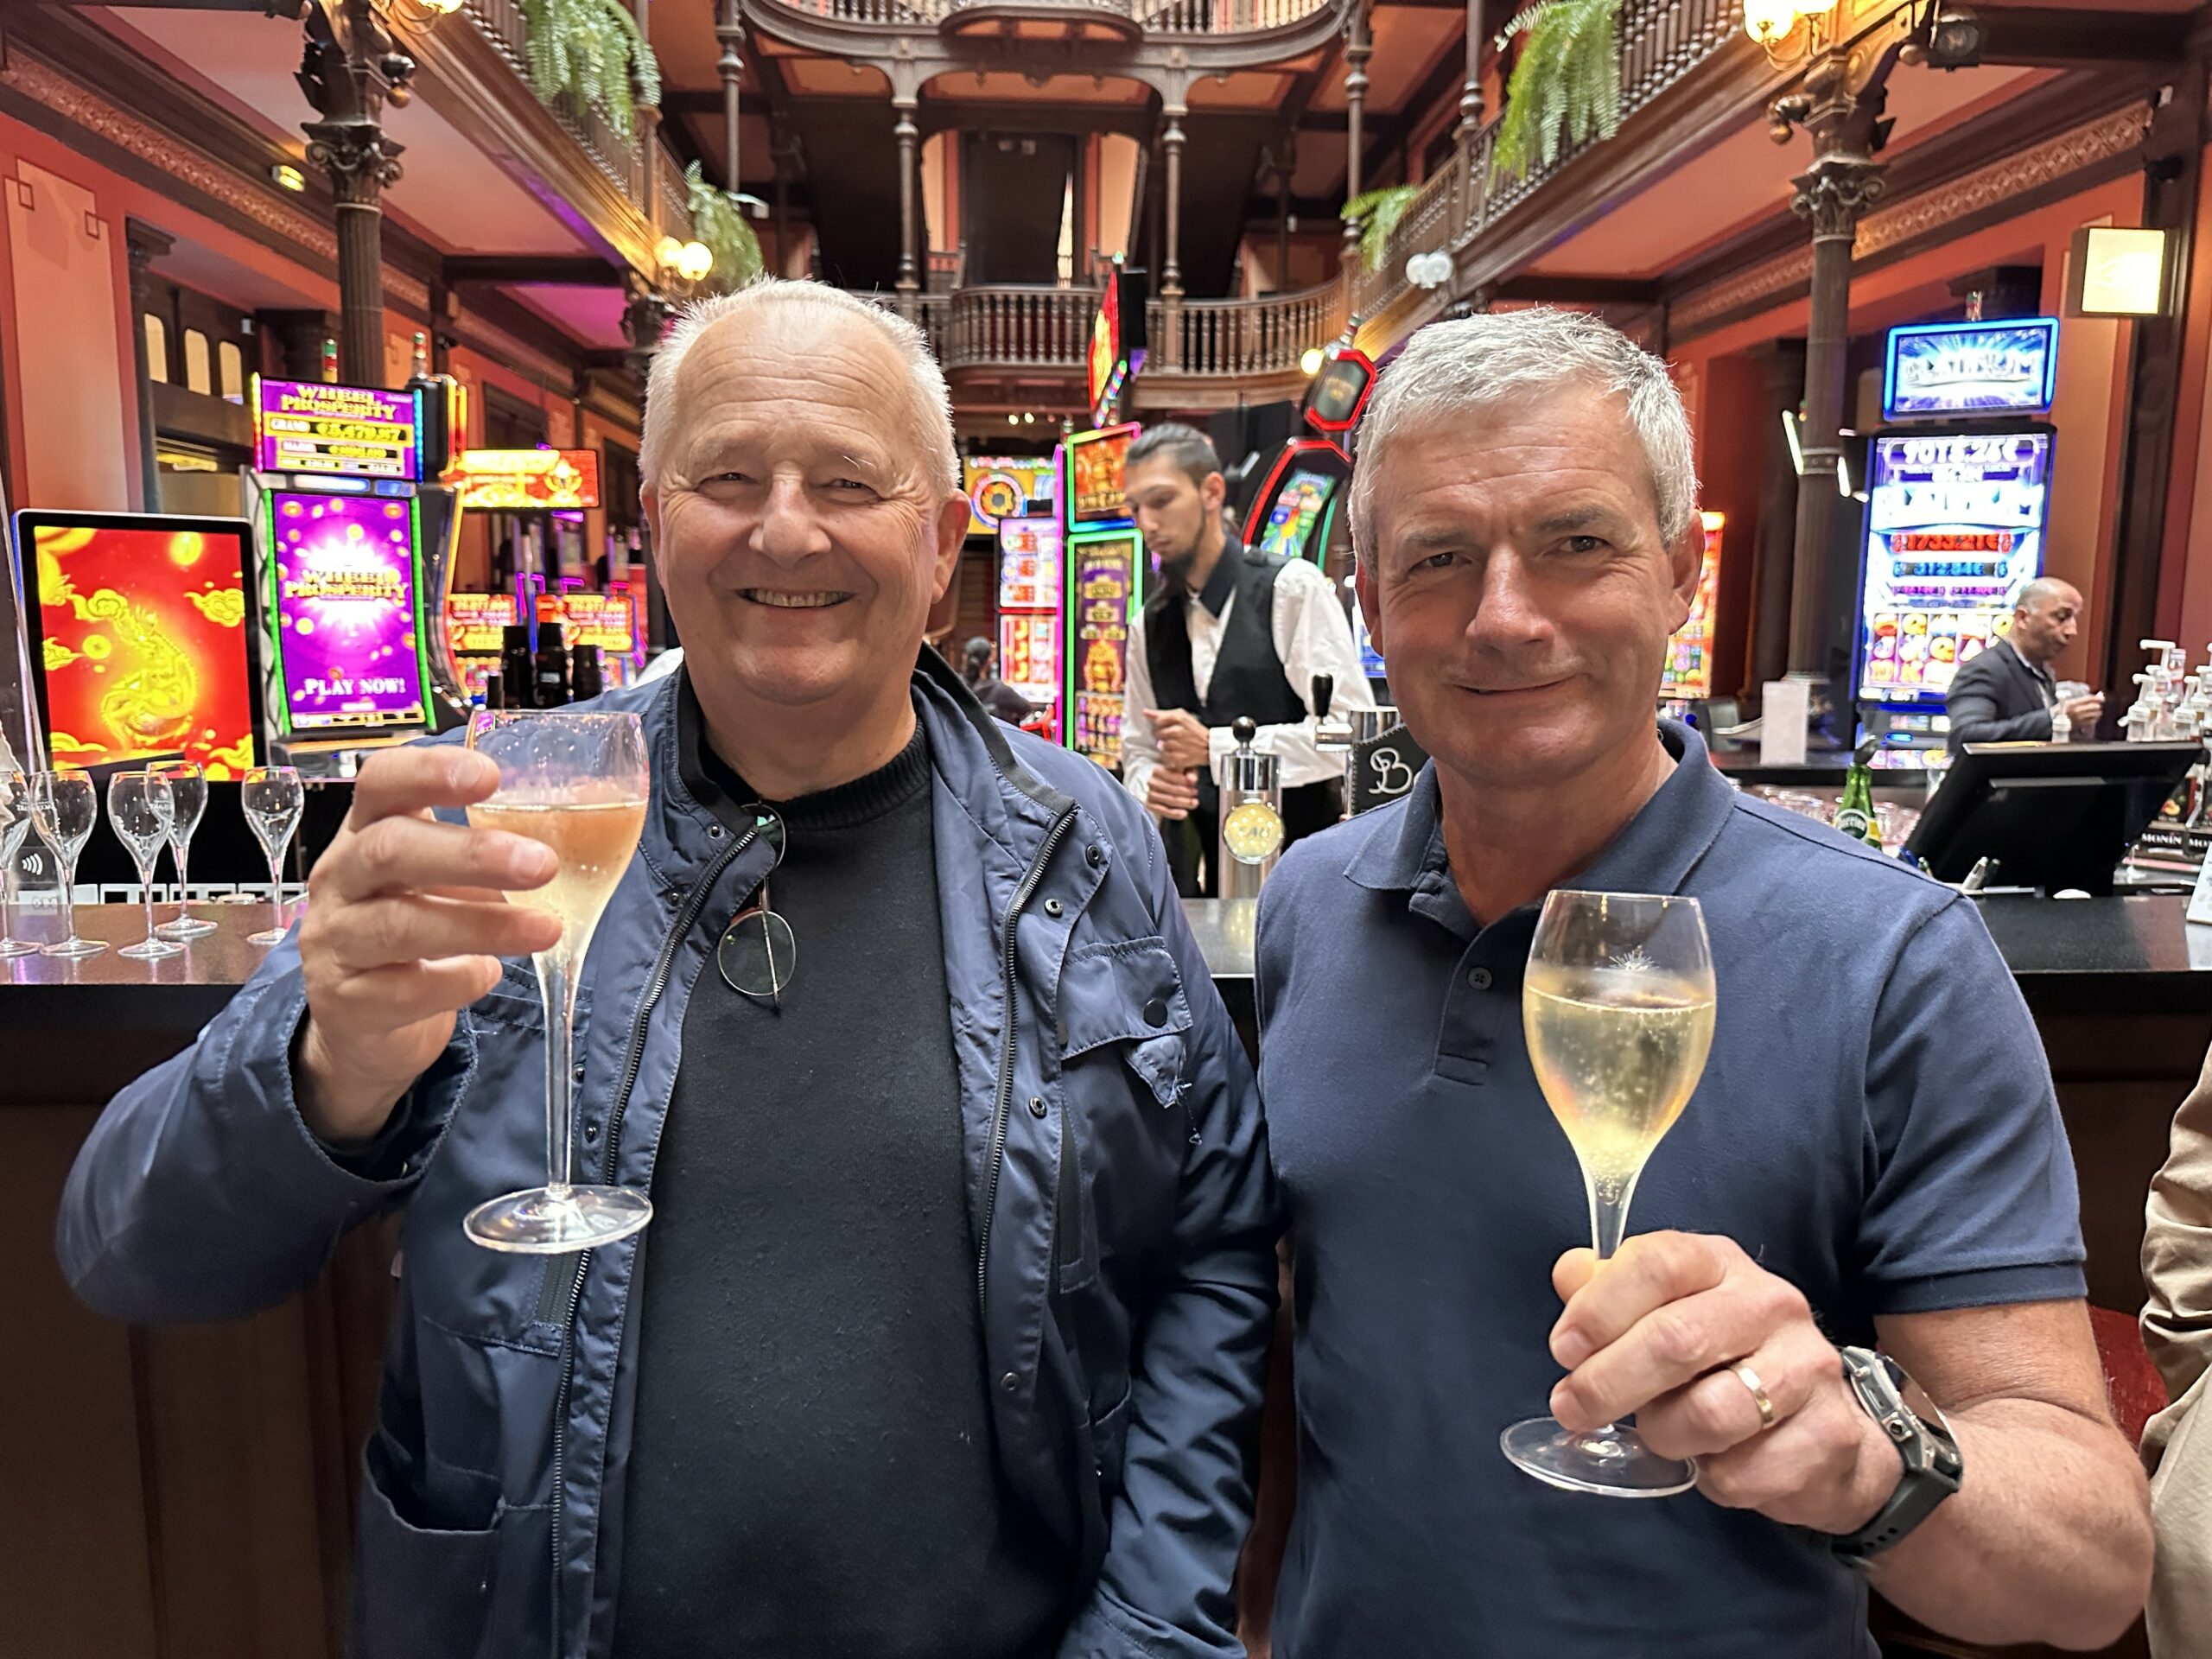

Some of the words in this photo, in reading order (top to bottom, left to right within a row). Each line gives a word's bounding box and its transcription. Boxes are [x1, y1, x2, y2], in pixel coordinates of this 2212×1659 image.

[296, 385, 375, 404] WHEEL
[281, 394, 397, 421] PROSPERITY
[284, 580, 409, 600] PROSPERITY
[304, 677, 353, 696] PLAY
[359, 677, 406, 695] NOW!
